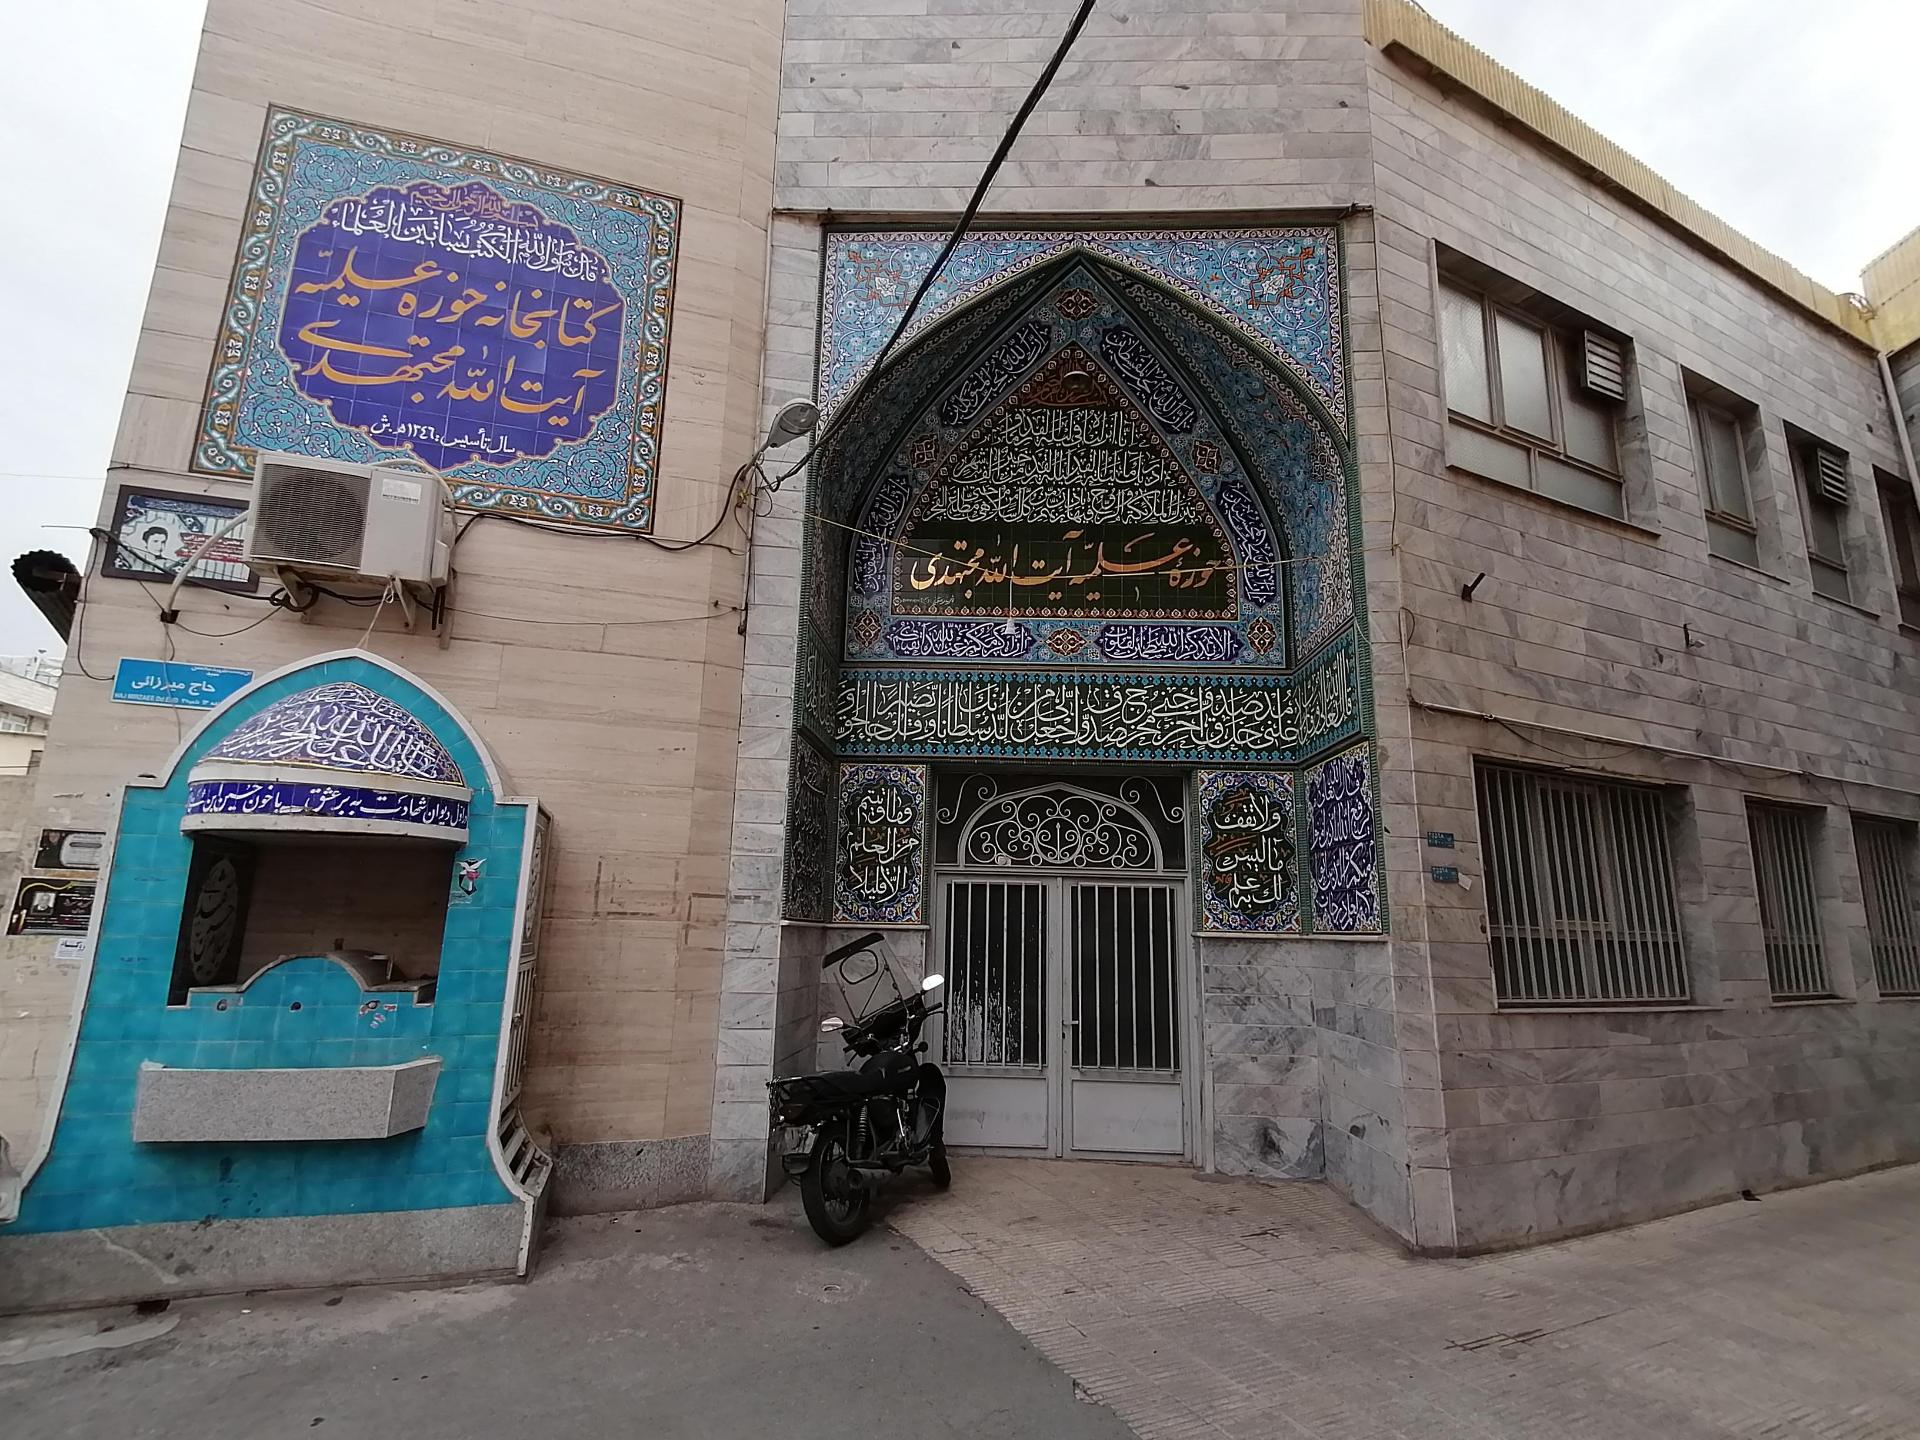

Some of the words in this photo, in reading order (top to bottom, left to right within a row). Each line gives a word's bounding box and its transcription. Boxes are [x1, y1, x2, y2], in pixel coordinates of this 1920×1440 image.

[436, 346, 516, 402] الله
[499, 368, 607, 428] آیت
[486, 436, 516, 453] سال
[187, 680, 216, 696] حاج
